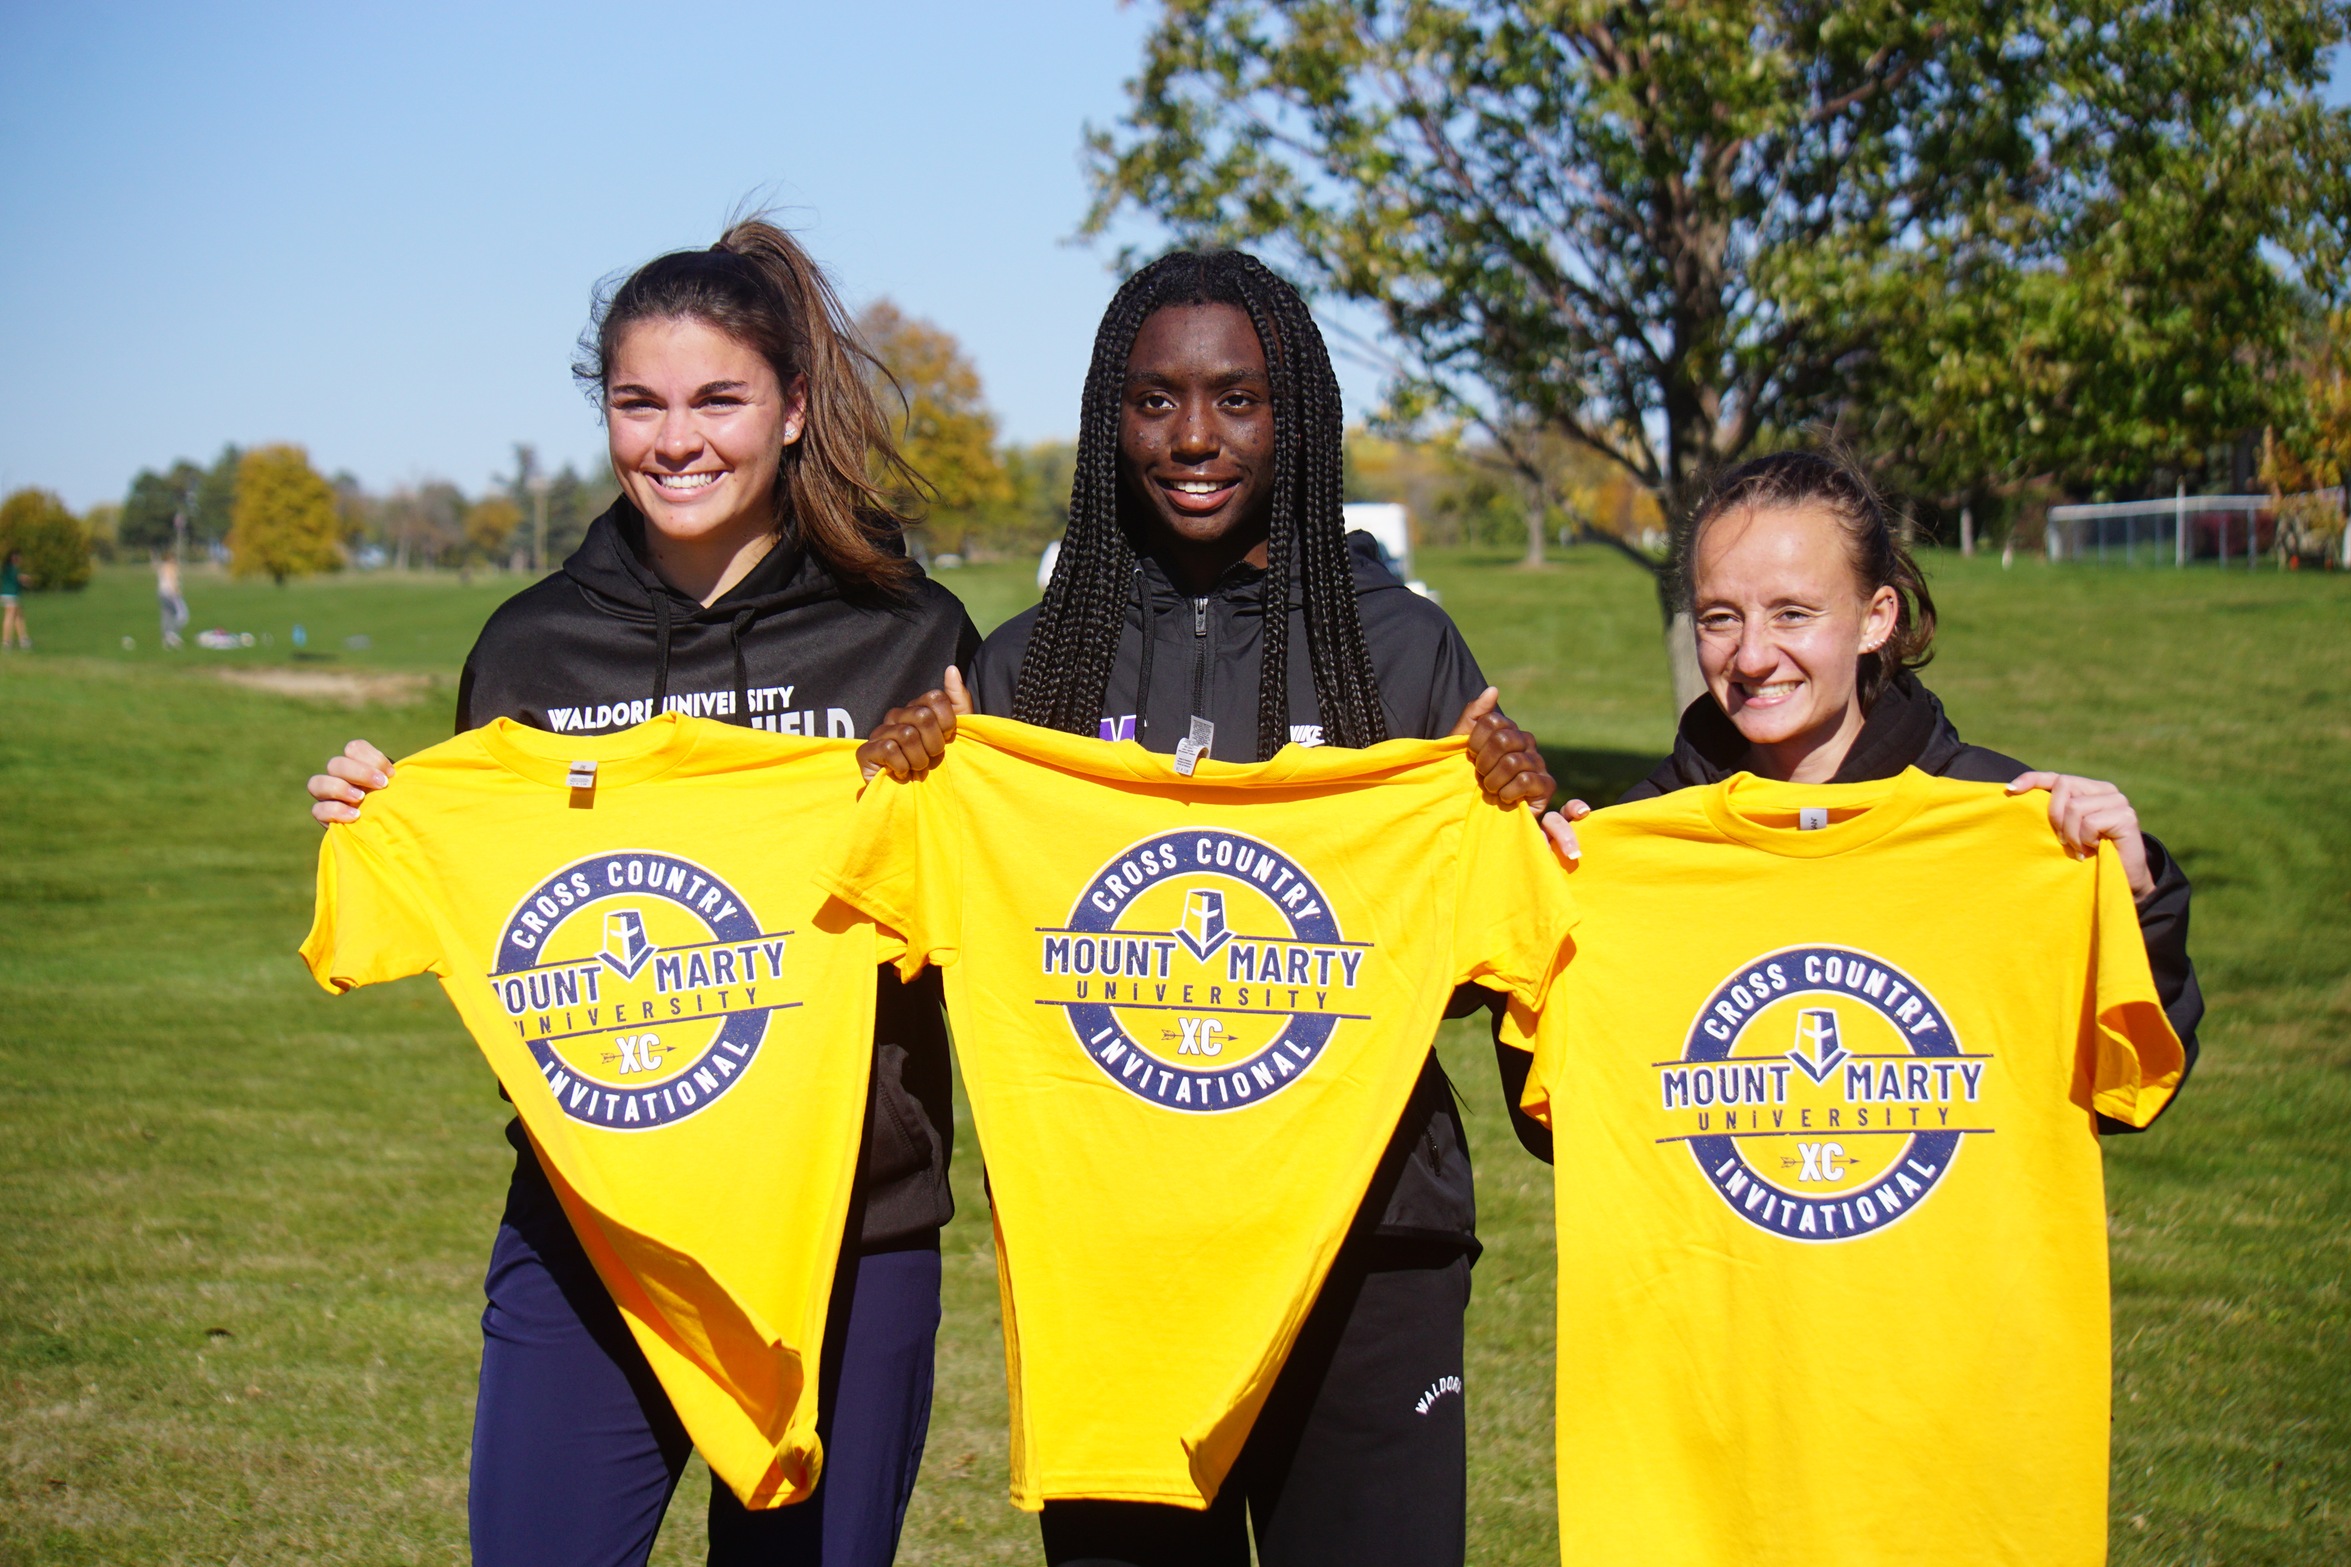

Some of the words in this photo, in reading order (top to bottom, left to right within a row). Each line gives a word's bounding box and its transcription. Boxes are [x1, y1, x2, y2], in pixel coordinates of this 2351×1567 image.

[1092, 843, 1176, 913] CROSS
[1197, 838, 1321, 920] COUNTRY
[511, 873, 591, 949] CROSS
[607, 860, 738, 923] COUNTRY
[491, 965, 603, 1015] OUNT
[655, 941, 784, 993] MARTY
[1044, 937, 1177, 978] MOUNT
[1229, 944, 1363, 987] MARTY
[1077, 980, 1327, 1009] UNIVERSITY
[1704, 963, 1786, 1040] CROSS
[1805, 955, 1938, 1035] COUNTRY
[615, 1033, 663, 1075] XC
[1178, 1017, 1223, 1056] XC
[541, 1040, 749, 1122] INVITATIONAL
[1091, 1026, 1311, 1104] INVITATIONAL
[1662, 1065, 1792, 1109] MOUNT
[1845, 1063, 1983, 1101] MARTY
[1698, 1106, 1950, 1131] UNIVERSITY
[1797, 1142, 1845, 1182] XC
[1715, 1158, 1937, 1233] INVITATIONAL
[1415, 1375, 1462, 1415] WALDOR
